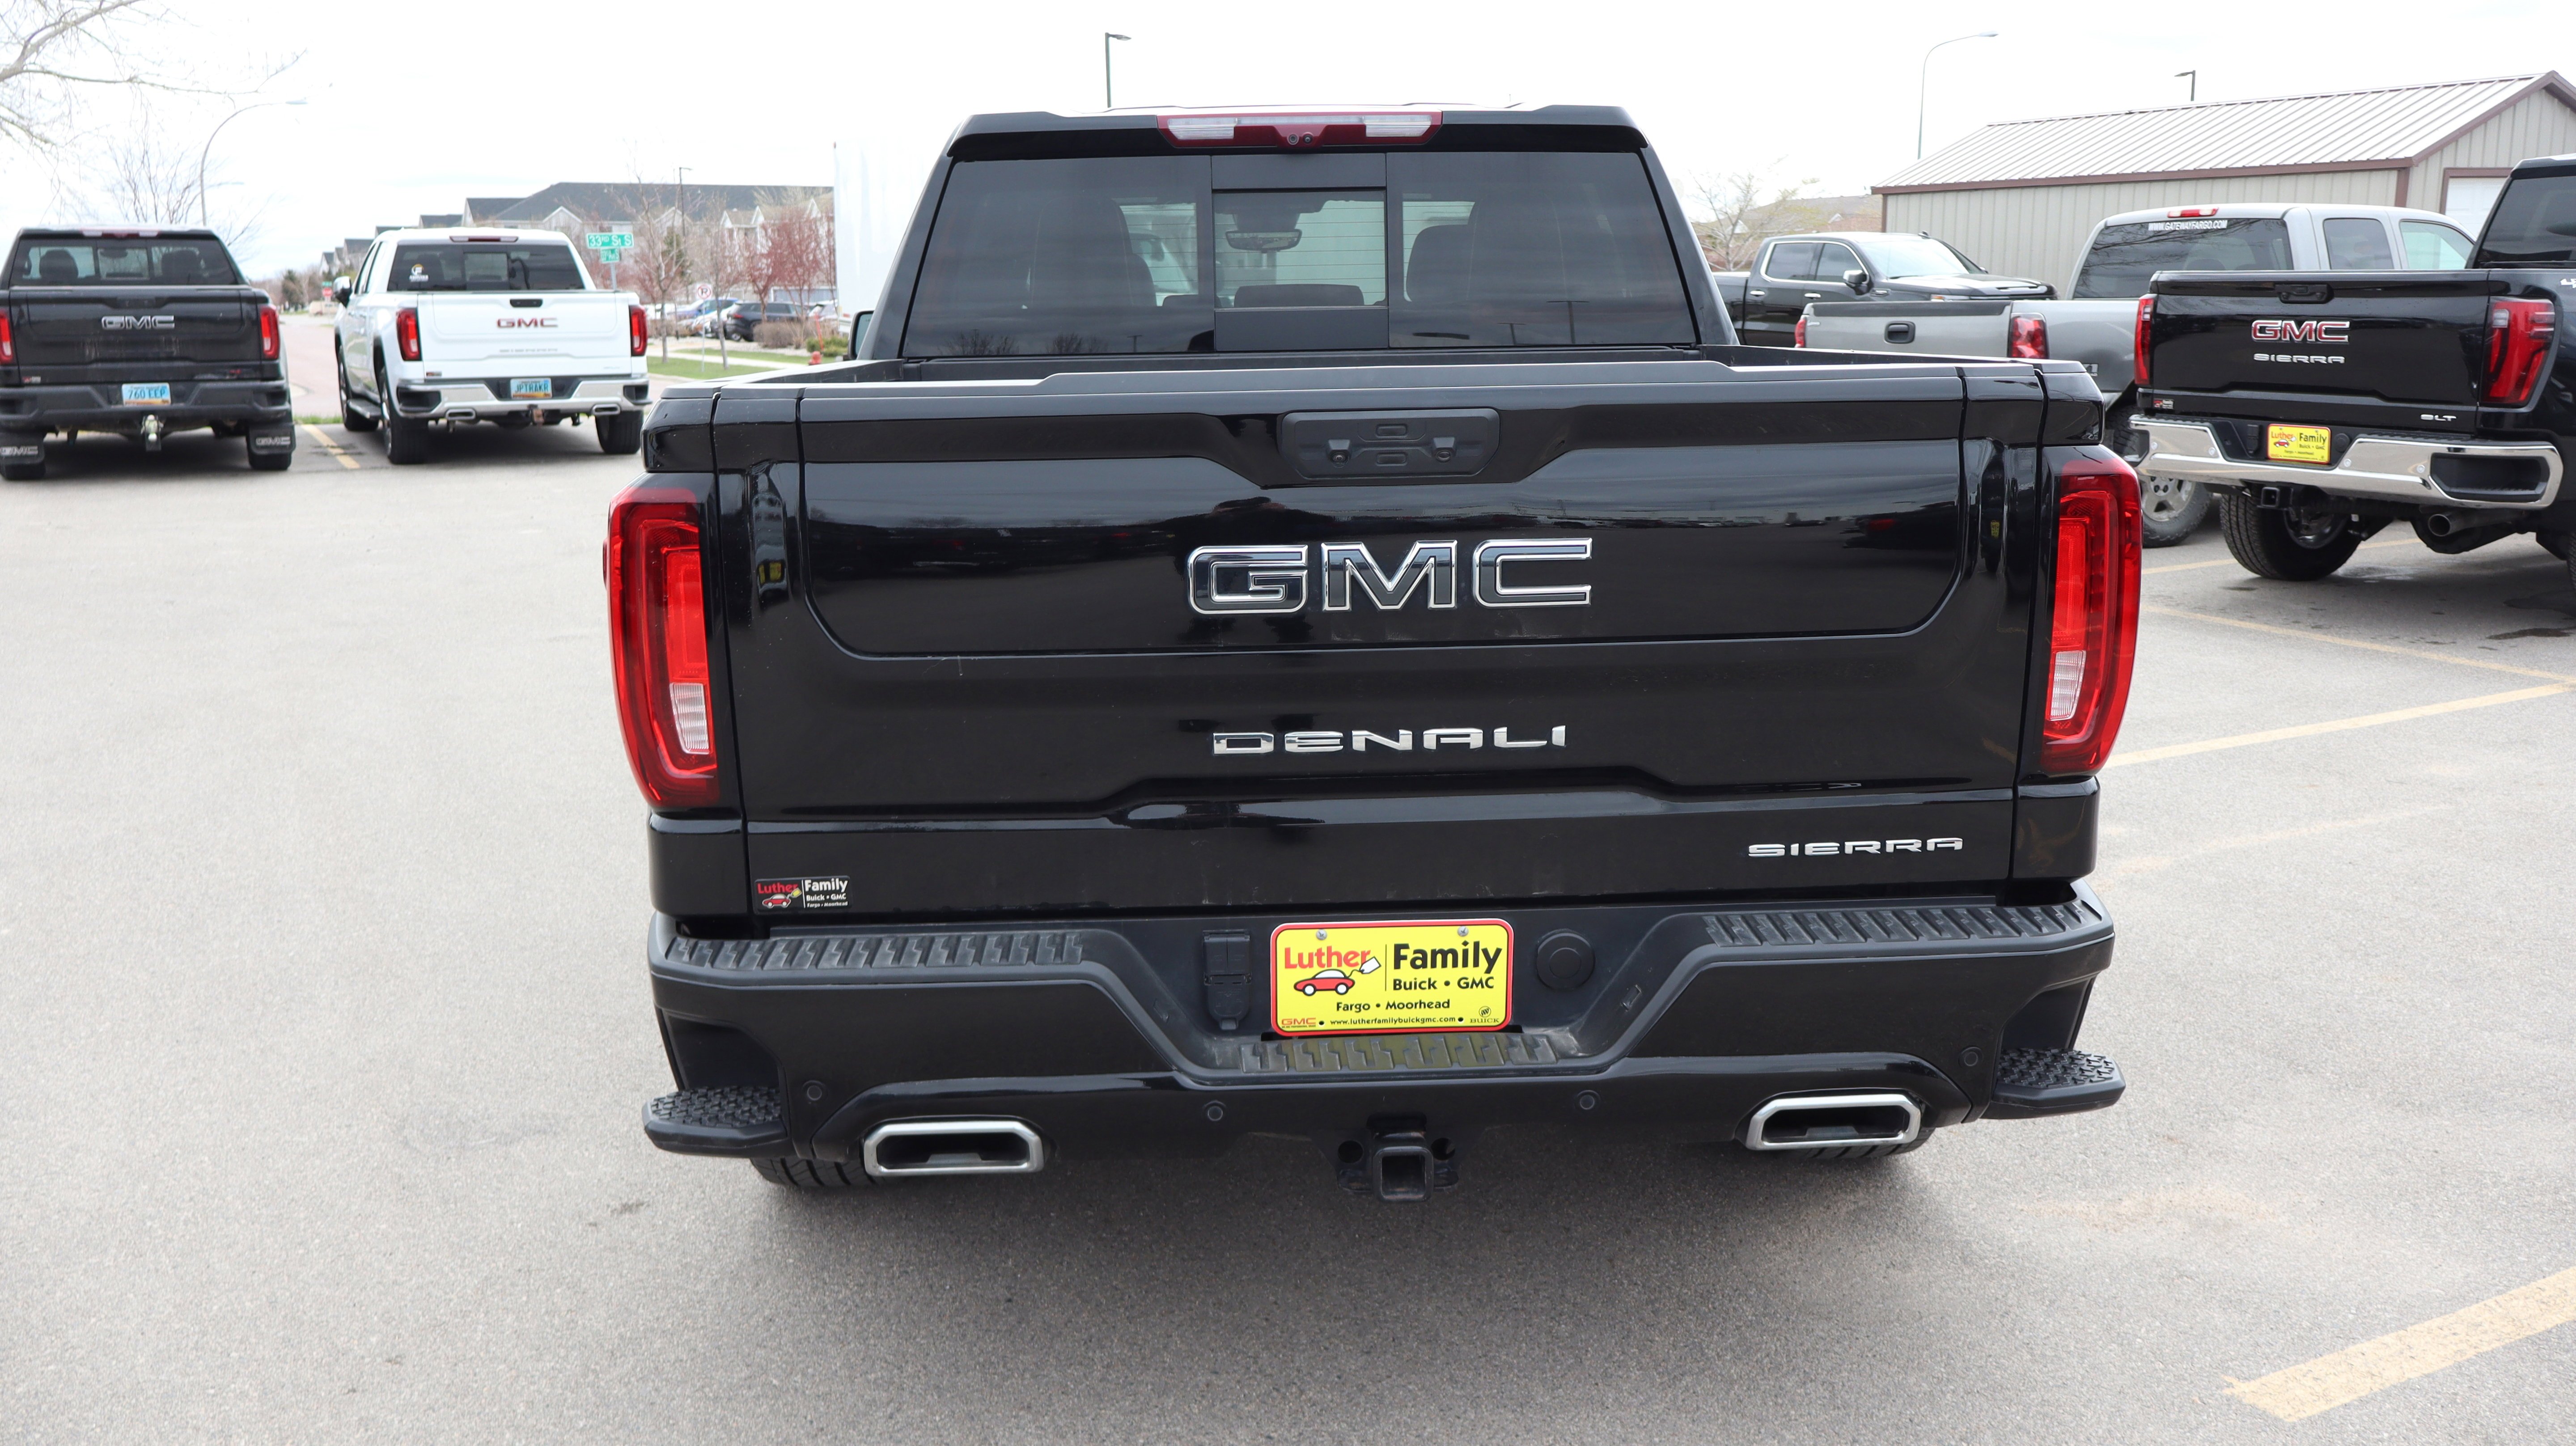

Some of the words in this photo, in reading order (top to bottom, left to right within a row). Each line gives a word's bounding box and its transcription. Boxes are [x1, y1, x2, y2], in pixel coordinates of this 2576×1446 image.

[2148, 220, 2228, 231] WWW.GATEWAYFARGO.COM
[624, 235, 631, 246] S
[102, 315, 175, 330] GMC
[497, 318, 558, 328] GMC
[2251, 320, 2350, 342] GMC
[2254, 353, 2345, 364] SIERRA
[128, 389, 146, 399] 760
[515, 383, 549, 392] JPTRAKR
[255, 436, 291, 445] GMC
[2271, 431, 2294, 439] Luther
[2299, 433, 2327, 445] Family
[1187, 538, 1593, 615] GMC
[1212, 725, 1566, 755] DENALI
[1748, 838, 1963, 857] SIERRA
[757, 882, 799, 894] Luther
[805, 878, 848, 892] Family
[1284, 946, 1371, 969] Luther
[1393, 940, 1502, 974] Family
[1393, 977, 1437, 991] Buick
[1457, 976, 1494, 989] GMC
[1336, 1002, 1371, 1013] Fargo
[1385, 999, 1450, 1010] Moorhead
[1330, 1016, 1456, 1026] www.lutherfamilybuickgmc.com
